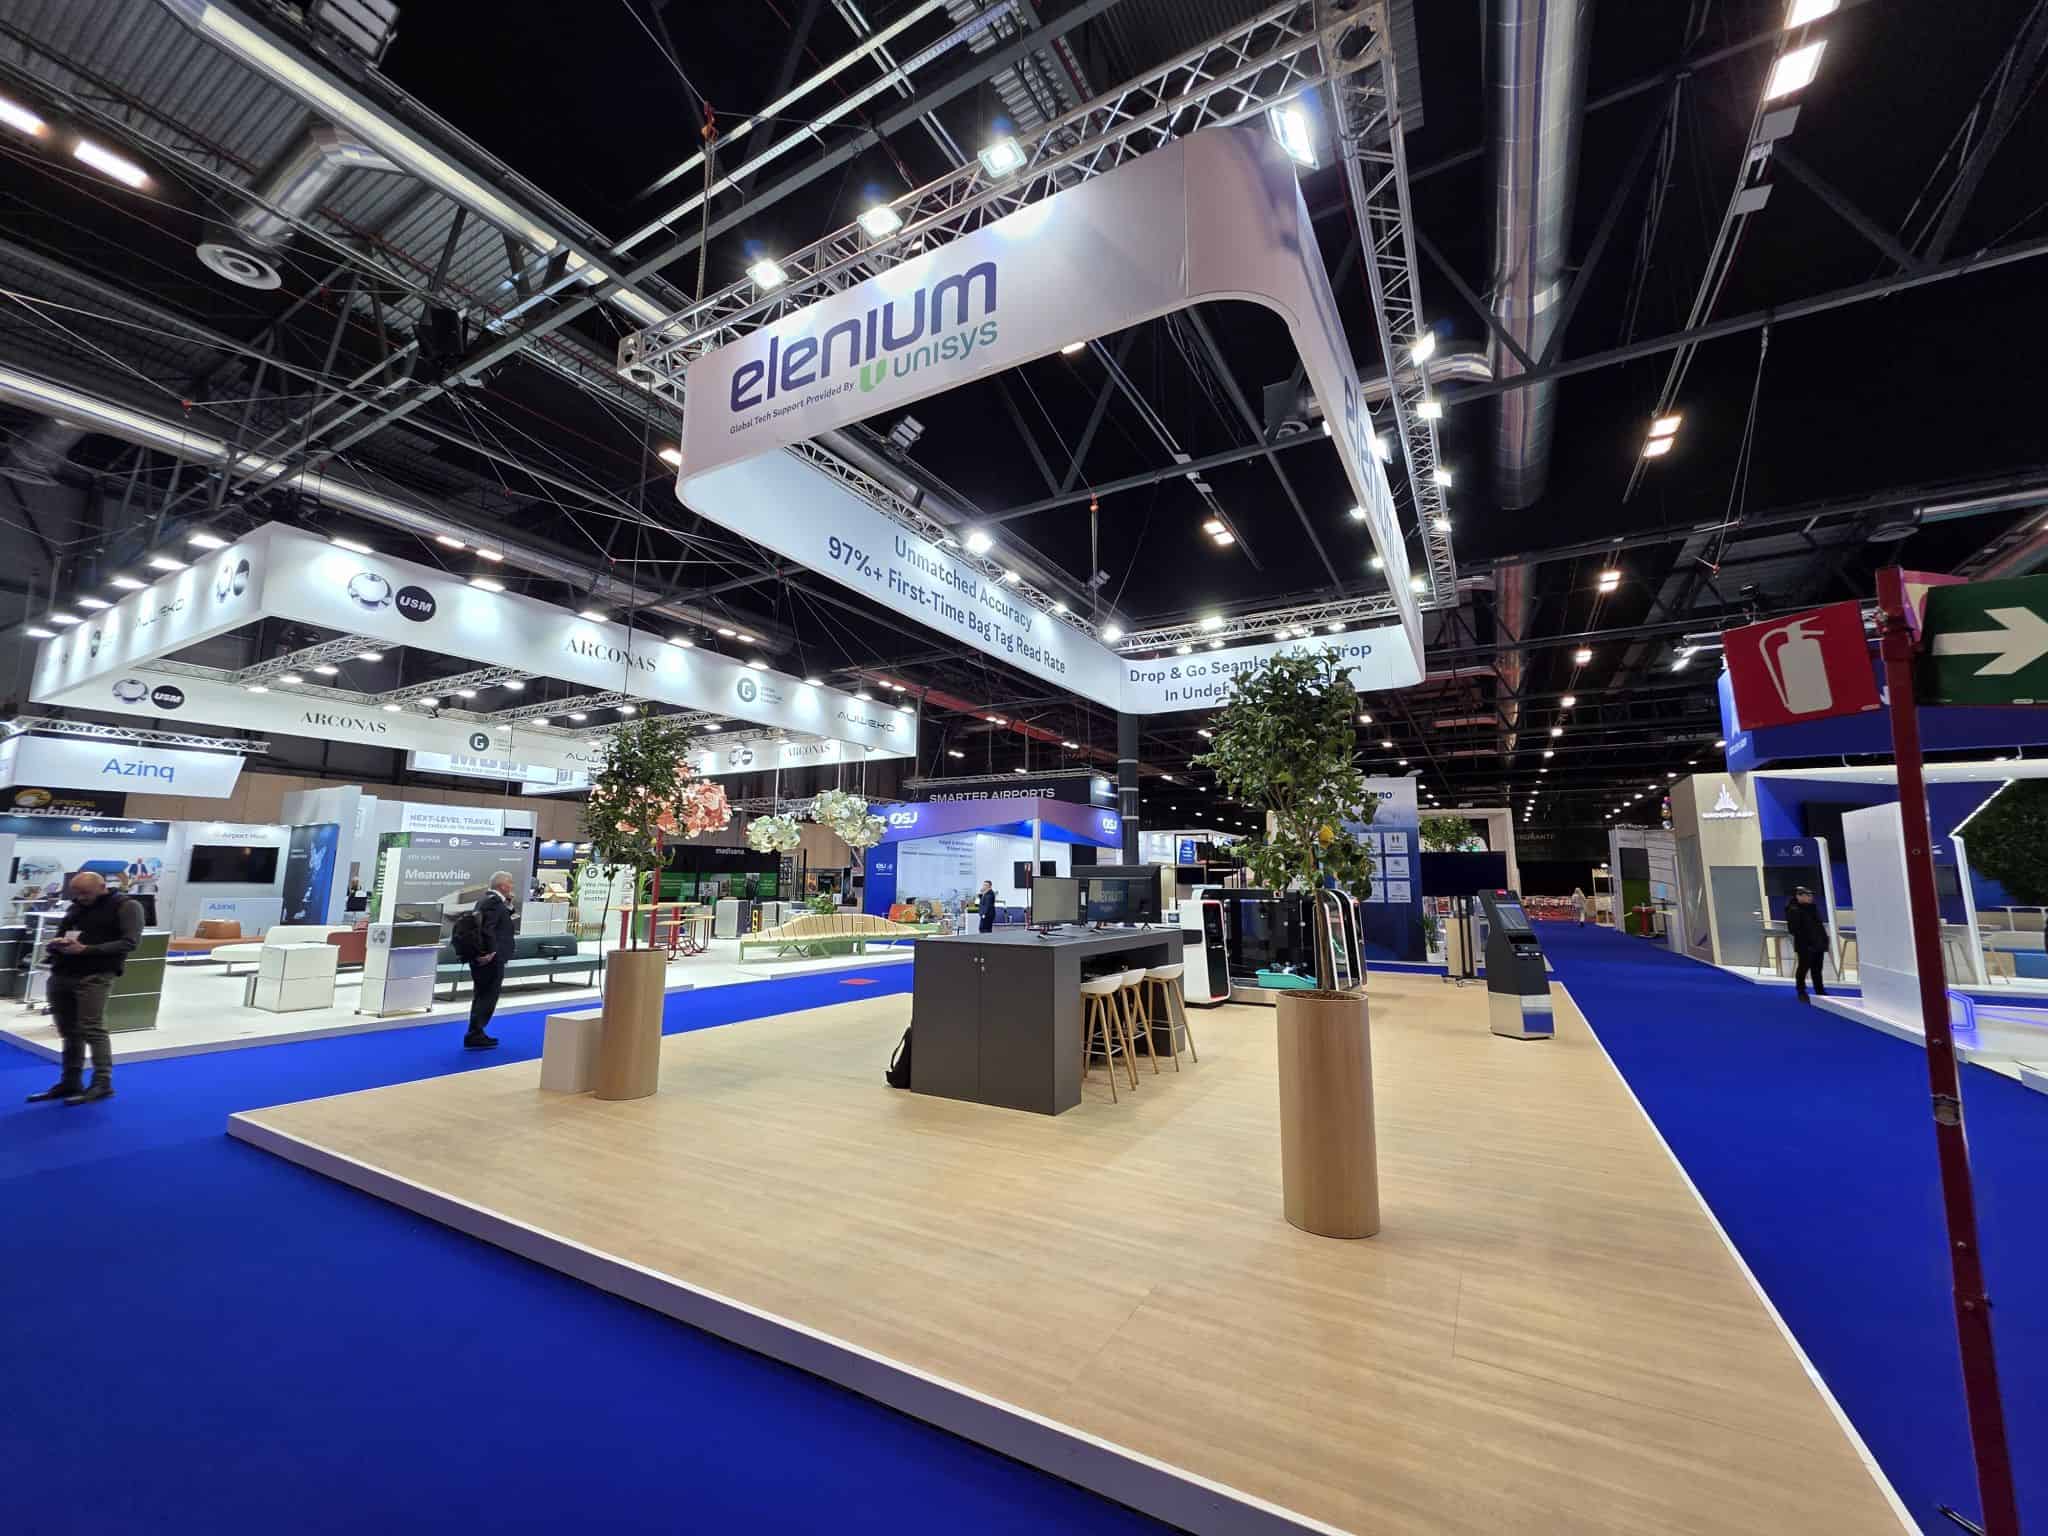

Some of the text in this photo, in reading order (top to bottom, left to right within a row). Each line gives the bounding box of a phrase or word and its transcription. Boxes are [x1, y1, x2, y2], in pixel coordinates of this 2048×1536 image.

[730, 261, 997, 413] elenium
[893, 320, 998, 378] unisys
[729, 382, 854, 435] Global Tech Support Provided By
[895, 535, 1033, 633] Unmatched Accuracy
[399, 595, 432, 613] USM
[828, 536, 1066, 674] 97%+ First-Time Bag Tag Read Rate
[566, 637, 657, 672] ARCONAS
[1129, 668, 1166, 684] Drop
[1169, 666, 1182, 679] &
[1186, 664, 1207, 678] Go
[154, 691, 182, 704] USM
[1165, 689, 1178, 701] In
[300, 712, 387, 734] ARCONAS
[102, 758, 175, 783] Azinq
[929, 788, 1056, 804] SMARTER AIRPORTS
[8, 805, 104, 818] mobility
[410, 814, 460, 824] NEXT-LEVEL
[81, 825, 115, 834] Airport
[405, 868, 471, 881] Meanwhile
